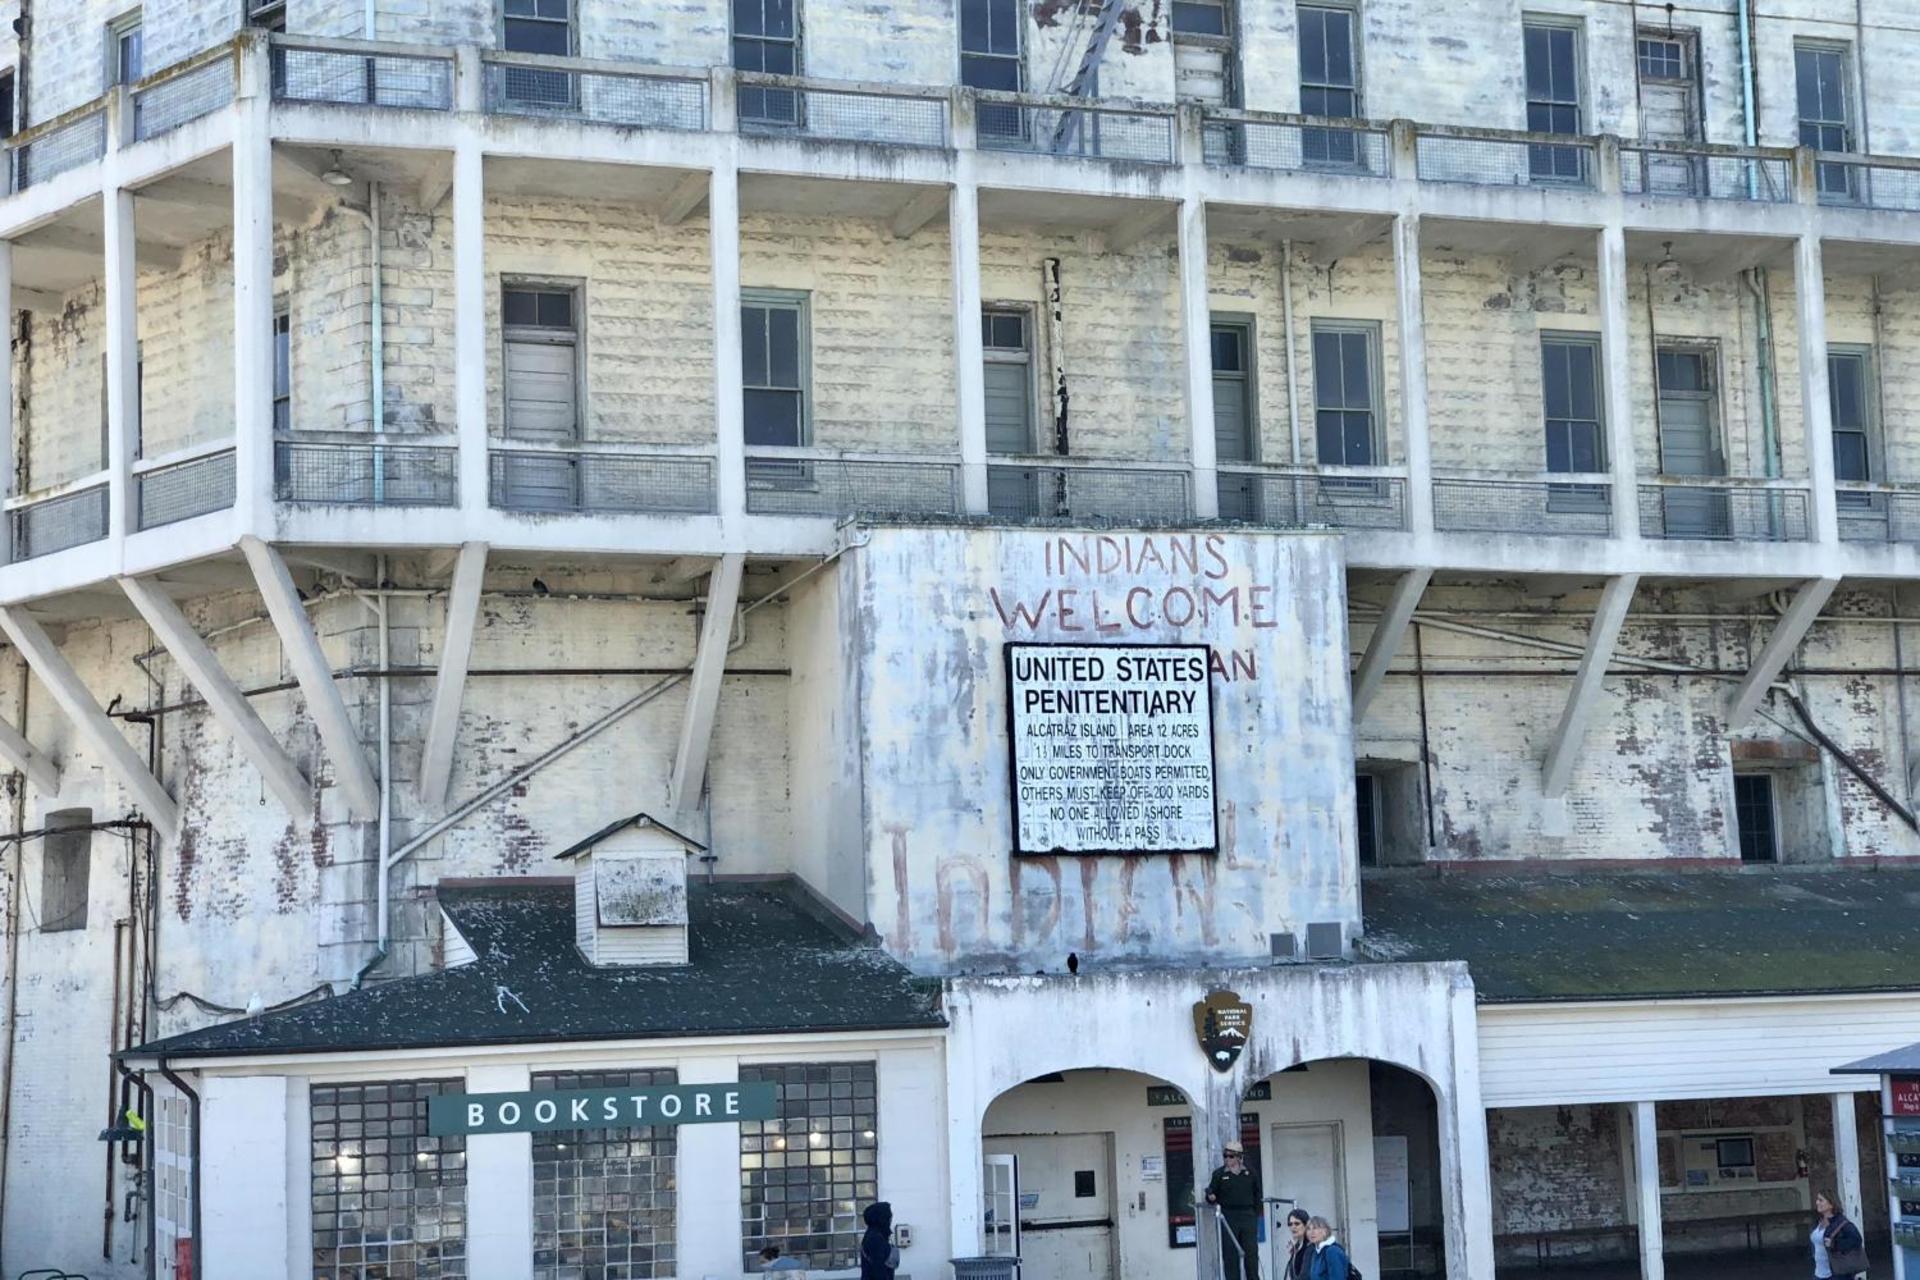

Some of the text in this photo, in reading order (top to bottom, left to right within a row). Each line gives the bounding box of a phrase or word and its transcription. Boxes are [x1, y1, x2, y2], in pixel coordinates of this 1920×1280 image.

[1045, 535, 1229, 580] INDIANS
[990, 586, 1279, 632] WELCOME
[1015, 656, 1204, 682] UNITED STATES
[1025, 690, 1197, 715] PENITENTIARY
[1026, 723, 1199, 738] ALCATRAZ ISLAND AREA 12 ACRES
[1052, 744, 1082, 759] MILES
[1086, 744, 1099, 759] TO
[1102, 744, 1160, 758] TRANSPORT
[1164, 744, 1192, 758] DOCK
[1020, 765, 1209, 780] ONLY GOVERNMENT BOATS PERMITTED
[1021, 786, 1063, 801] OTHERS
[1067, 786, 1095, 800] MUST
[1100, 786, 1126, 799] KEEP
[1153, 785, 1174, 799] 200
[1176, 785, 1210, 799] YARDS
[1050, 805, 1184, 820] NO ONE ALLOWED ASHORE
[1076, 826, 1161, 841] WITHOUT A PASS
[467, 1091, 740, 1127] BOOKSTORE
